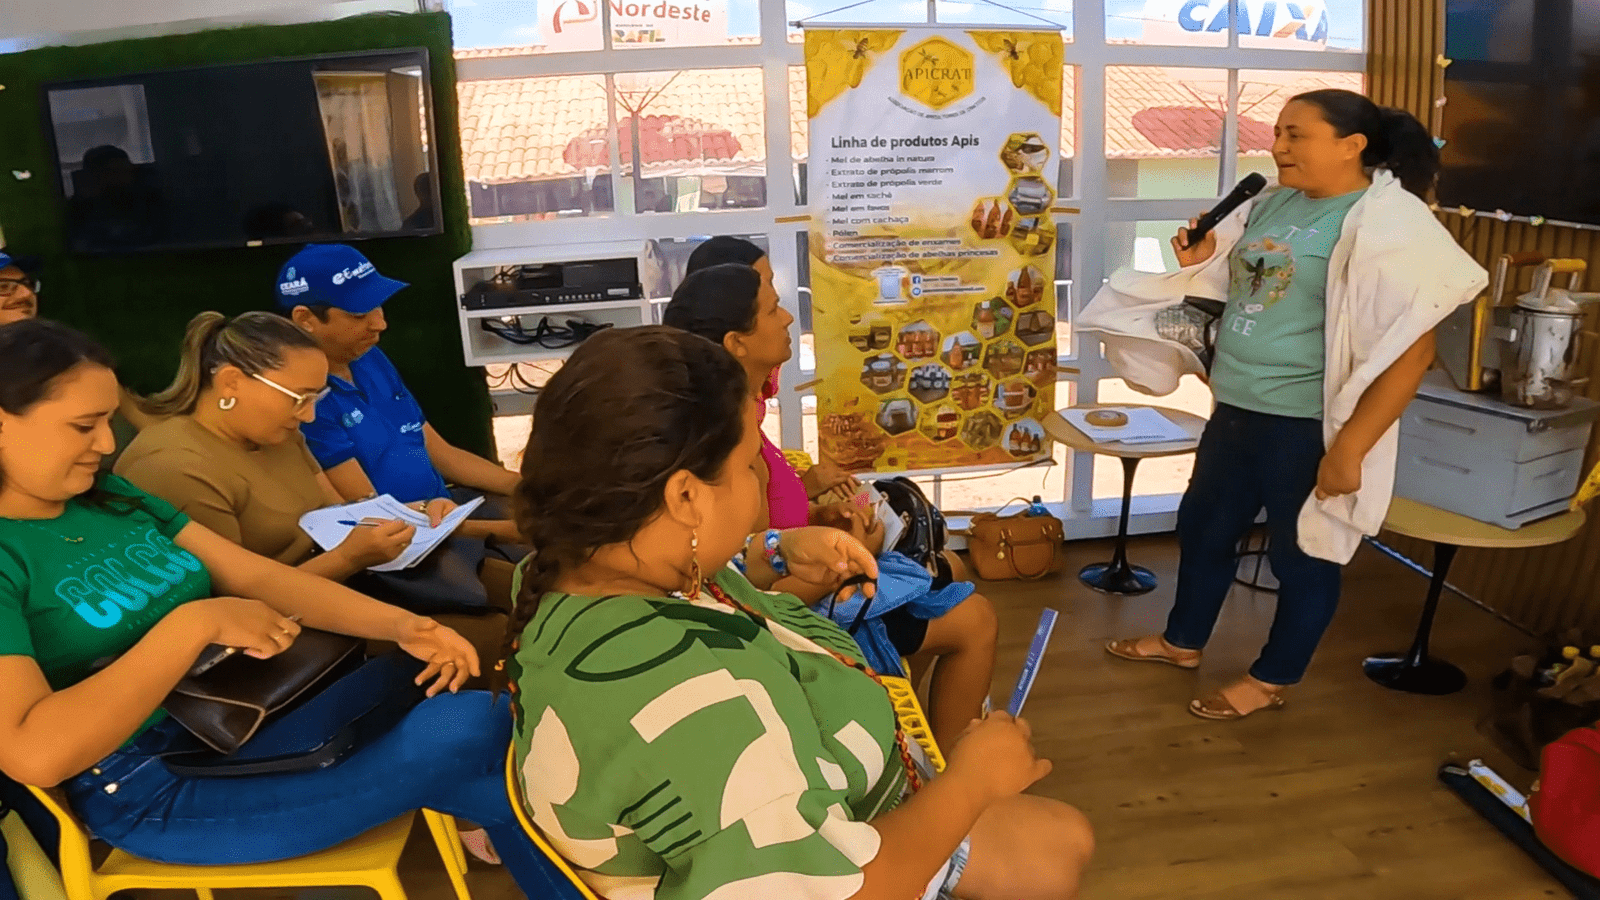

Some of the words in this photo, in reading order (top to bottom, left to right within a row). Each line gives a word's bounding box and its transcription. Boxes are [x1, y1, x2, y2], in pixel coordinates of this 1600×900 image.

[609, 0, 711, 22] Nordeste
[1178, 0, 1328, 45] CAIXA
[904, 67, 972, 80] APICRAT
[831, 136, 867, 148] Linha
[870, 136, 887, 148] de
[890, 136, 948, 150] produtos
[951, 134, 980, 149] Apis
[880, 167, 916, 176] própolis
[880, 179, 916, 188] própolis
[832, 192, 848, 200] Mel
[873, 216, 909, 225] cachaça
[833, 240, 906, 249] Comercialização
[833, 252, 906, 262] Comercialização
[922, 250, 956, 258] abelhas
[958, 249, 998, 258] princesas
